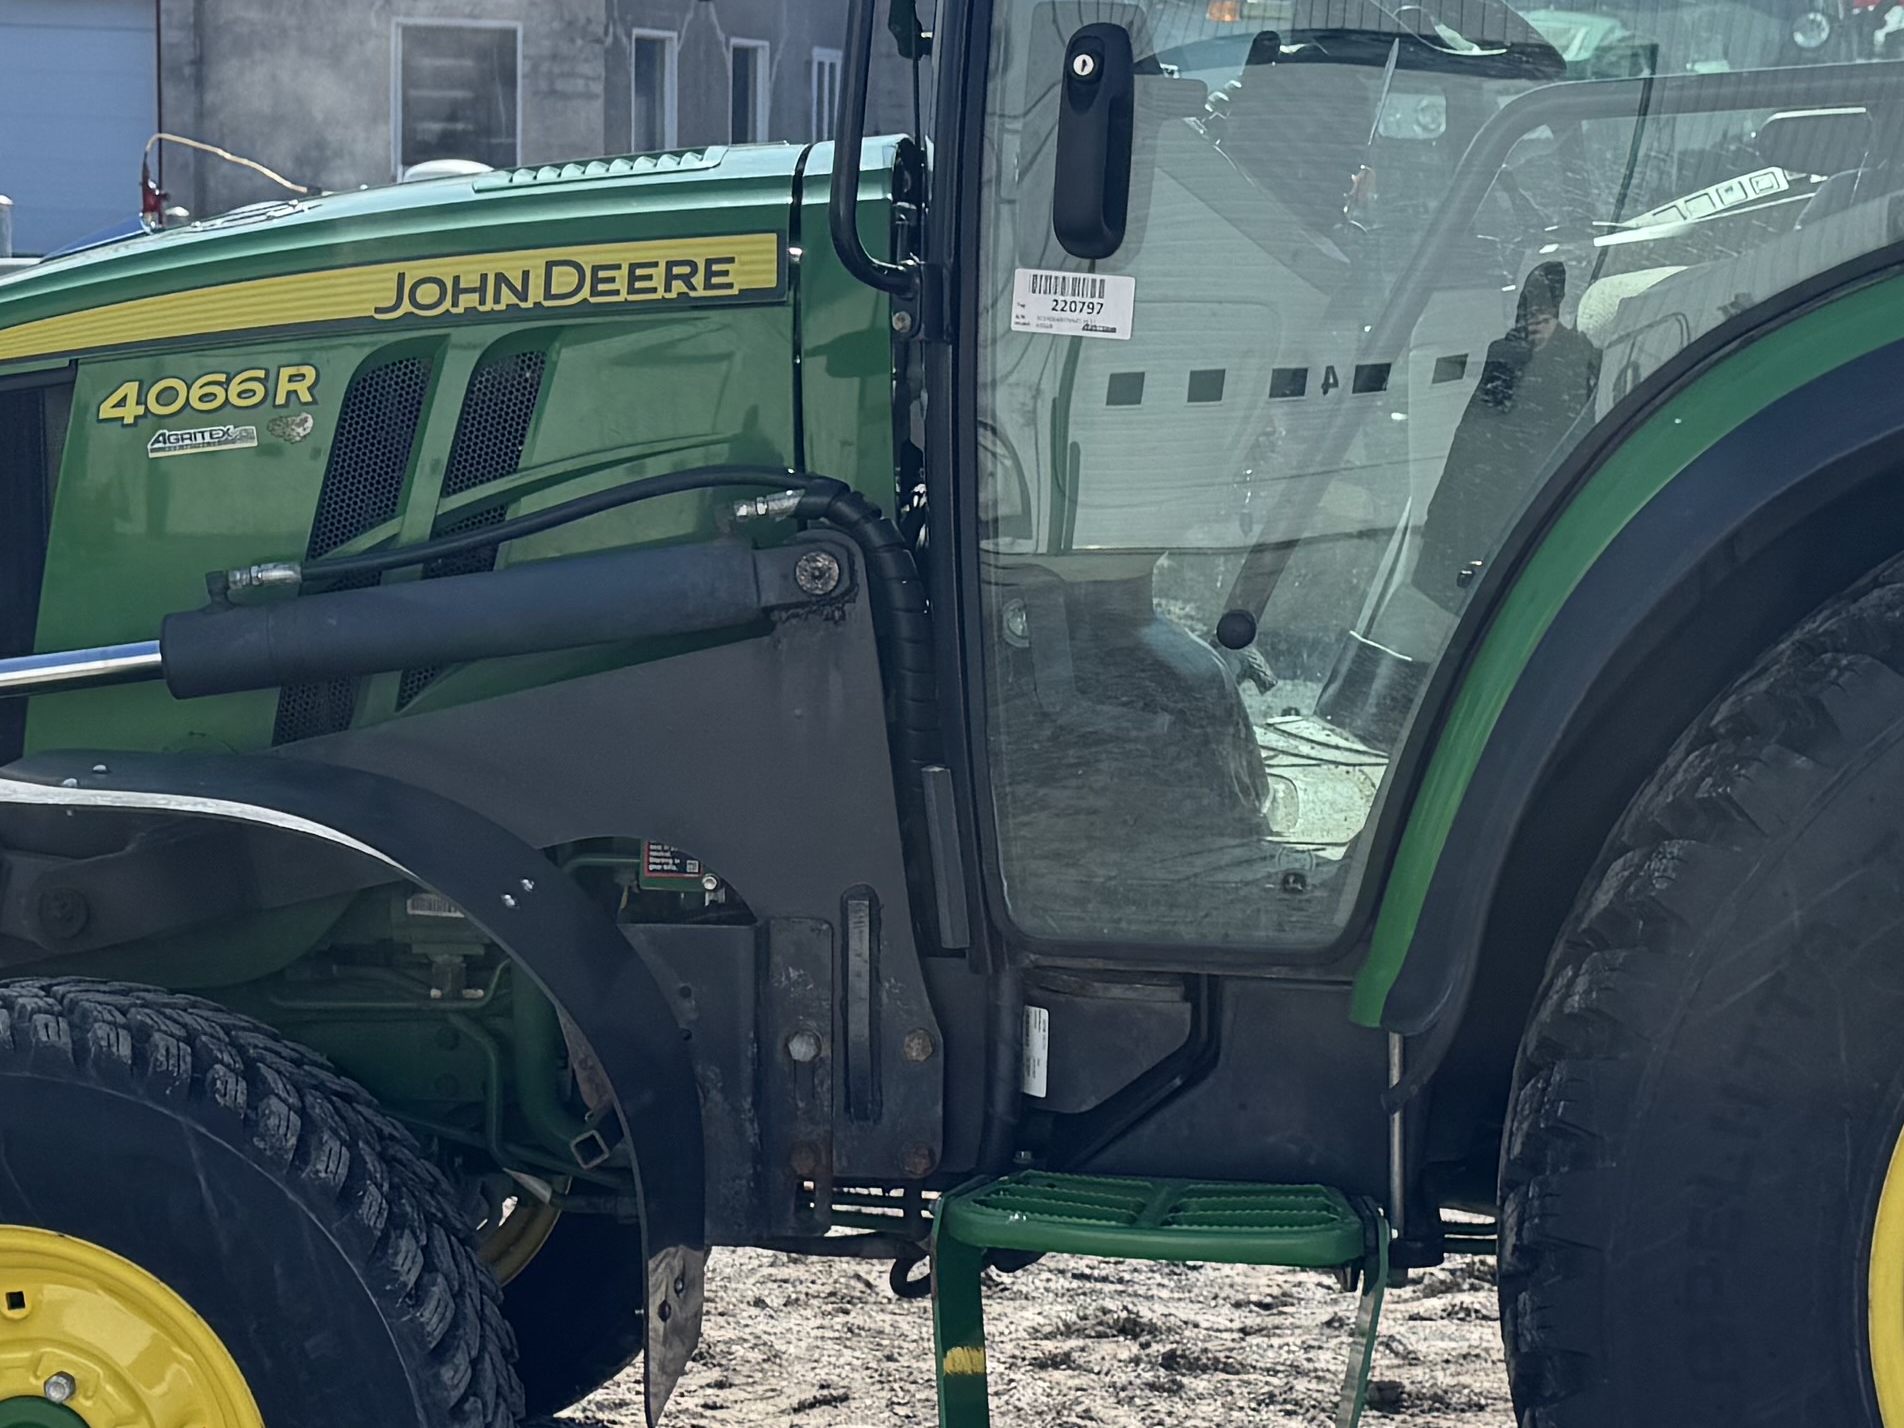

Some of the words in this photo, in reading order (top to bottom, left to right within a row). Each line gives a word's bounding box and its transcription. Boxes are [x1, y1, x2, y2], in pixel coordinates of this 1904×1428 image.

[374, 269, 530, 315] JOHN
[542, 256, 736, 303] DEERE
[1051, 299, 1104, 315] 220797
[150, 426, 233, 446] AGRITEX
